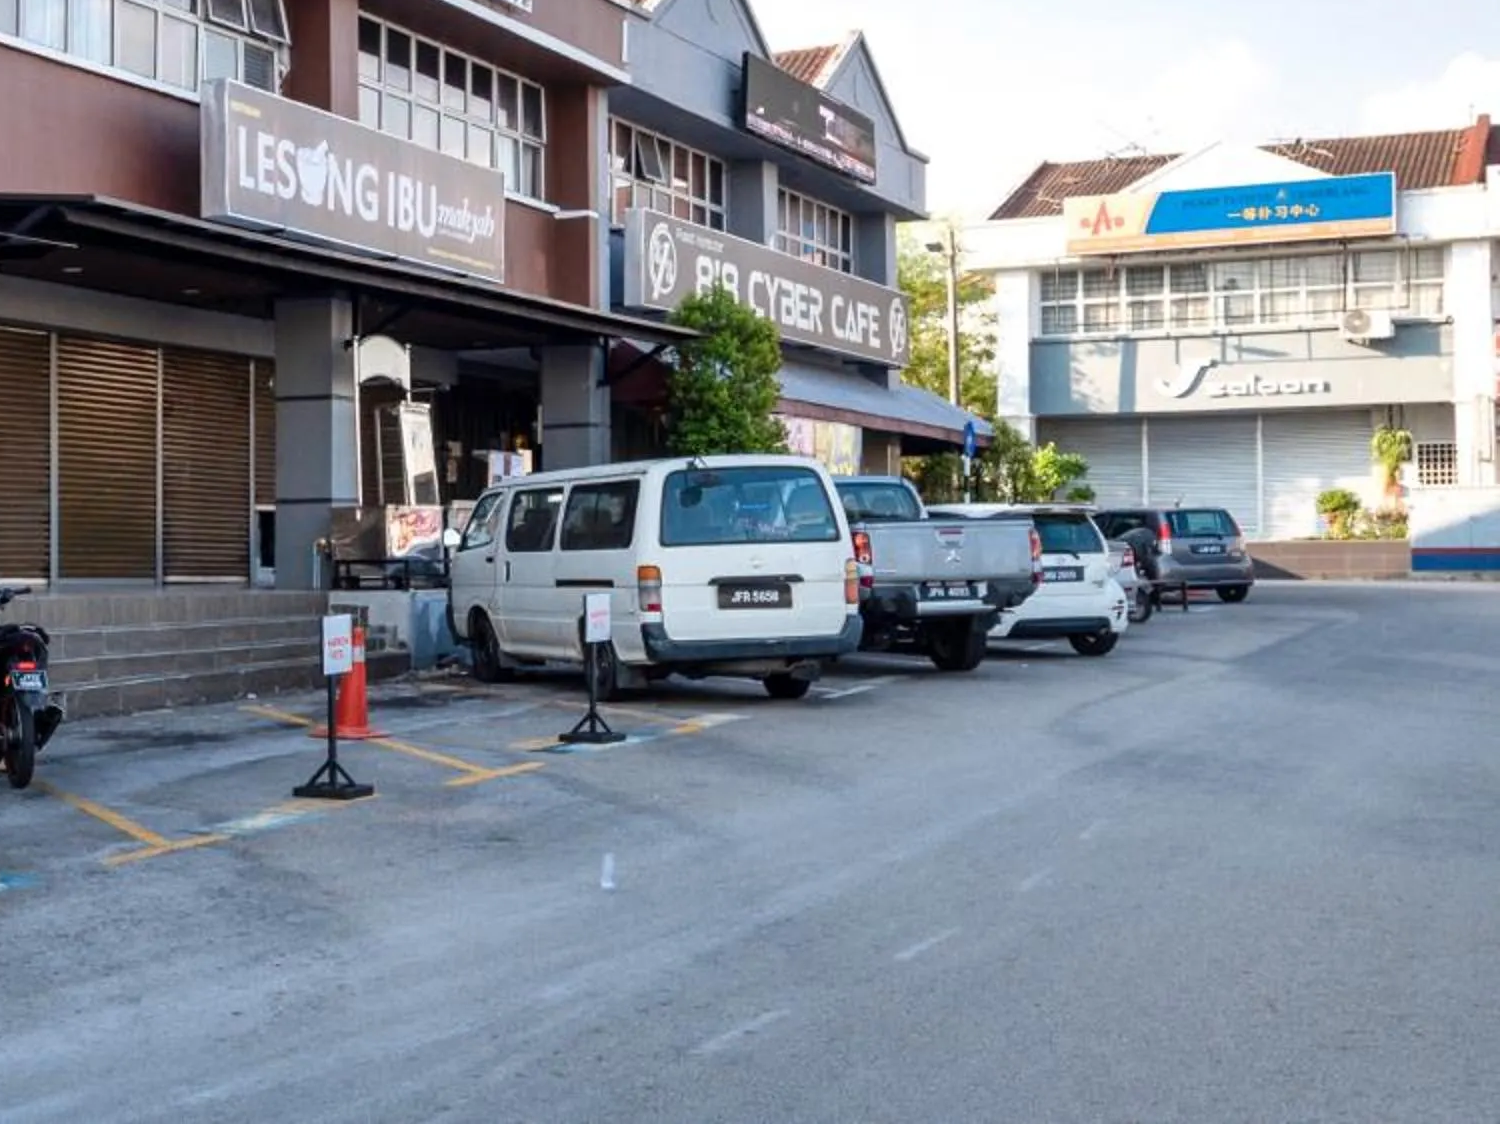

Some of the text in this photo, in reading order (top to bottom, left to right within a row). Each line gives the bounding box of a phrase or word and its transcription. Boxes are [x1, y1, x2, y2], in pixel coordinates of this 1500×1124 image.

[387, 171, 437, 238] IBU
[747, 270, 824, 335] CYBER
[831, 294, 882, 350] CAFE
